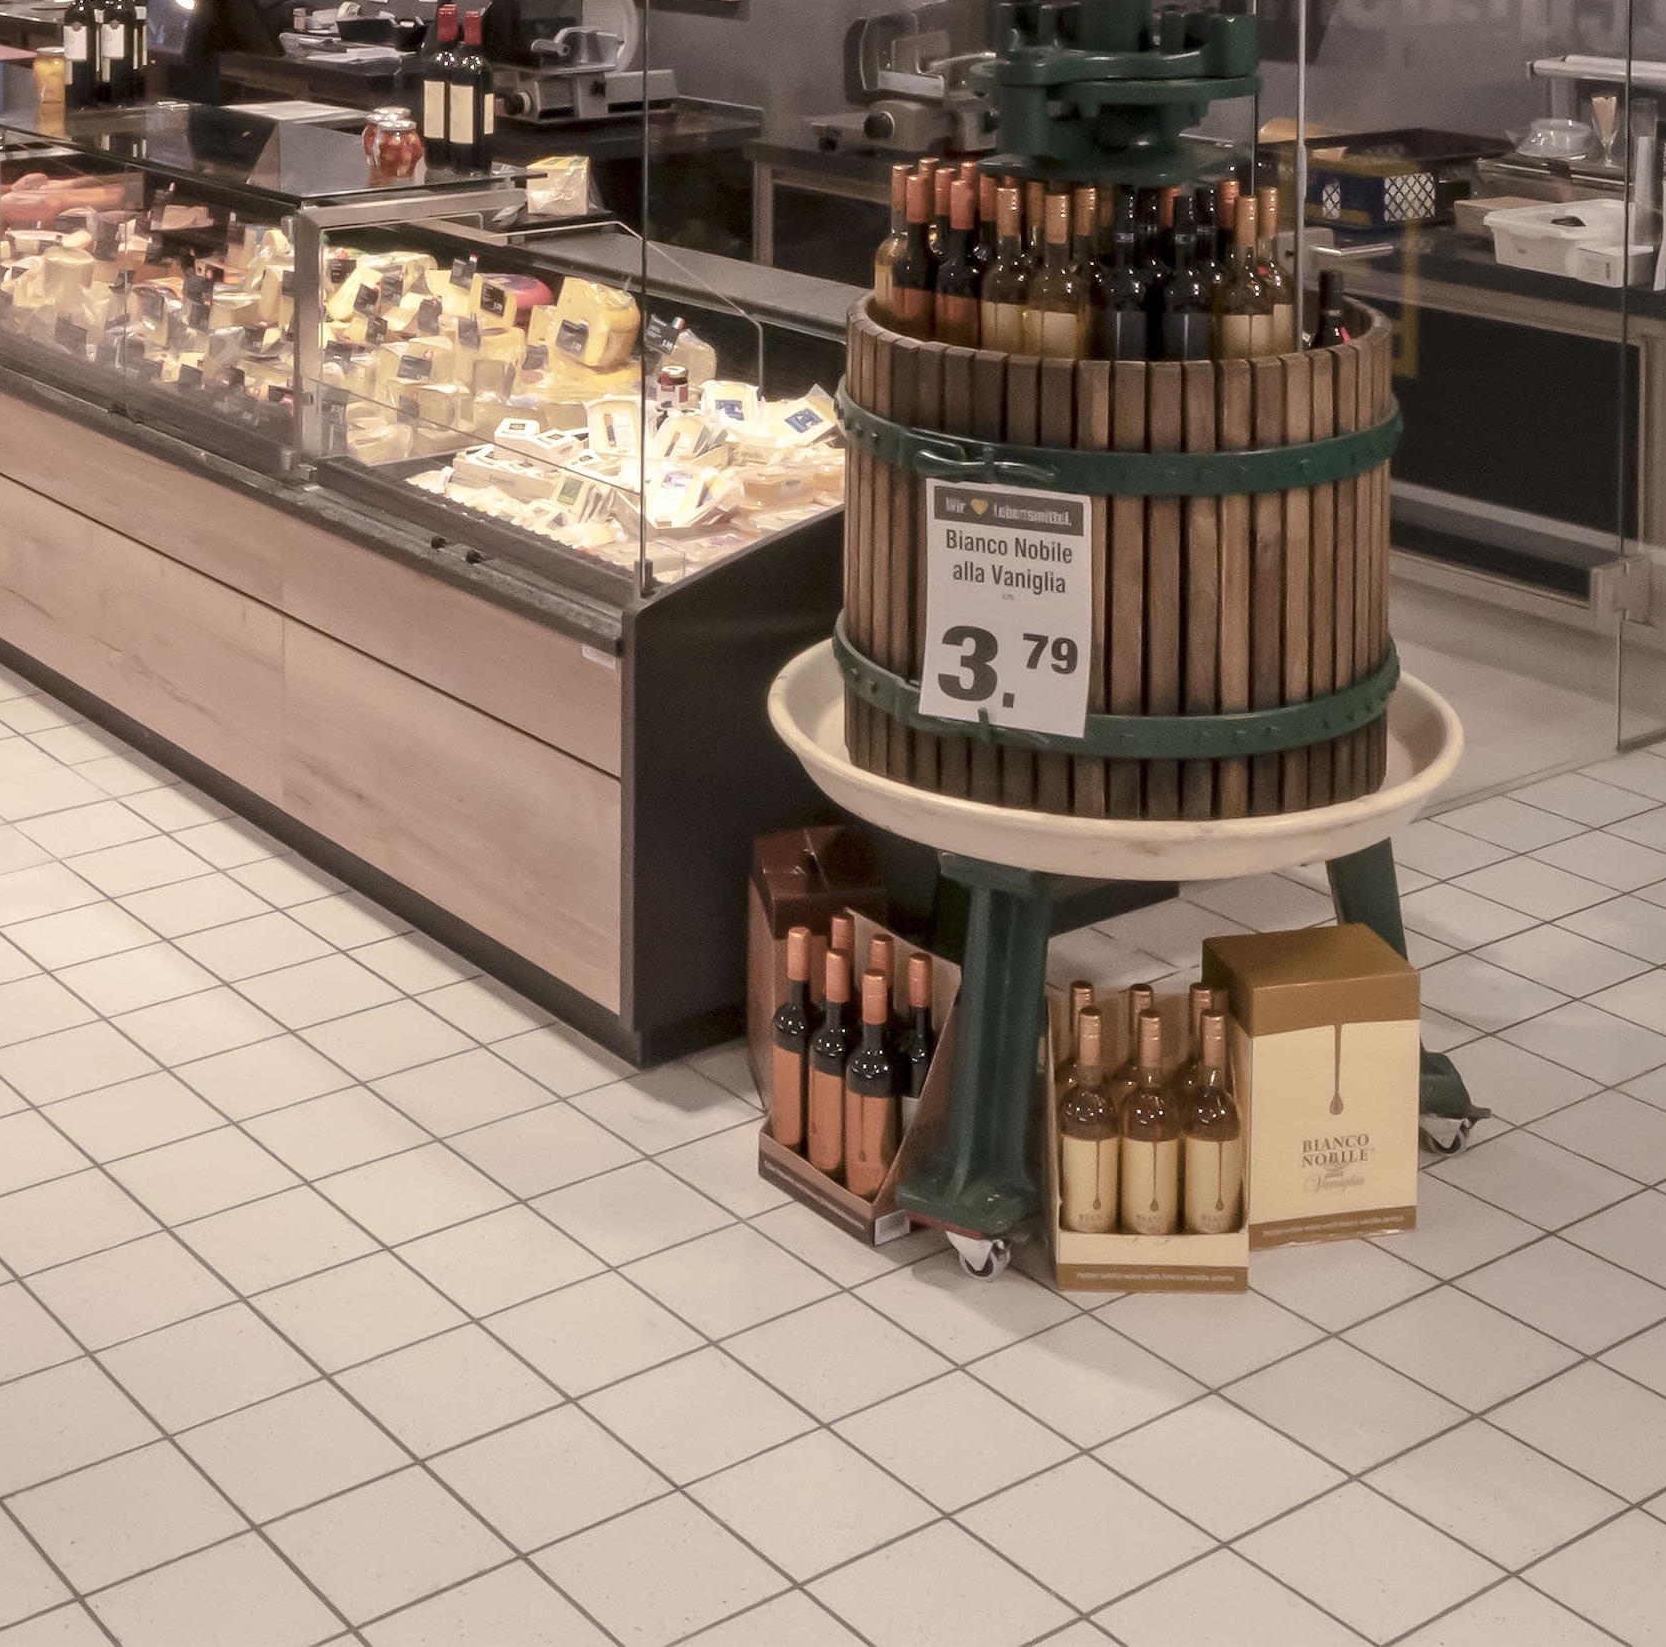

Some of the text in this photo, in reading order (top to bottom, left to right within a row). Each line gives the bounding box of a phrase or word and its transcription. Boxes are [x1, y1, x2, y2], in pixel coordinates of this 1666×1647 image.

[946, 528, 1073, 564] Bianco Nobile
[953, 560, 1066, 595] alla Vaniglia
[1302, 1134, 1369, 1153] BIANCO
[1301, 1148, 1369, 1169] NOBILE
